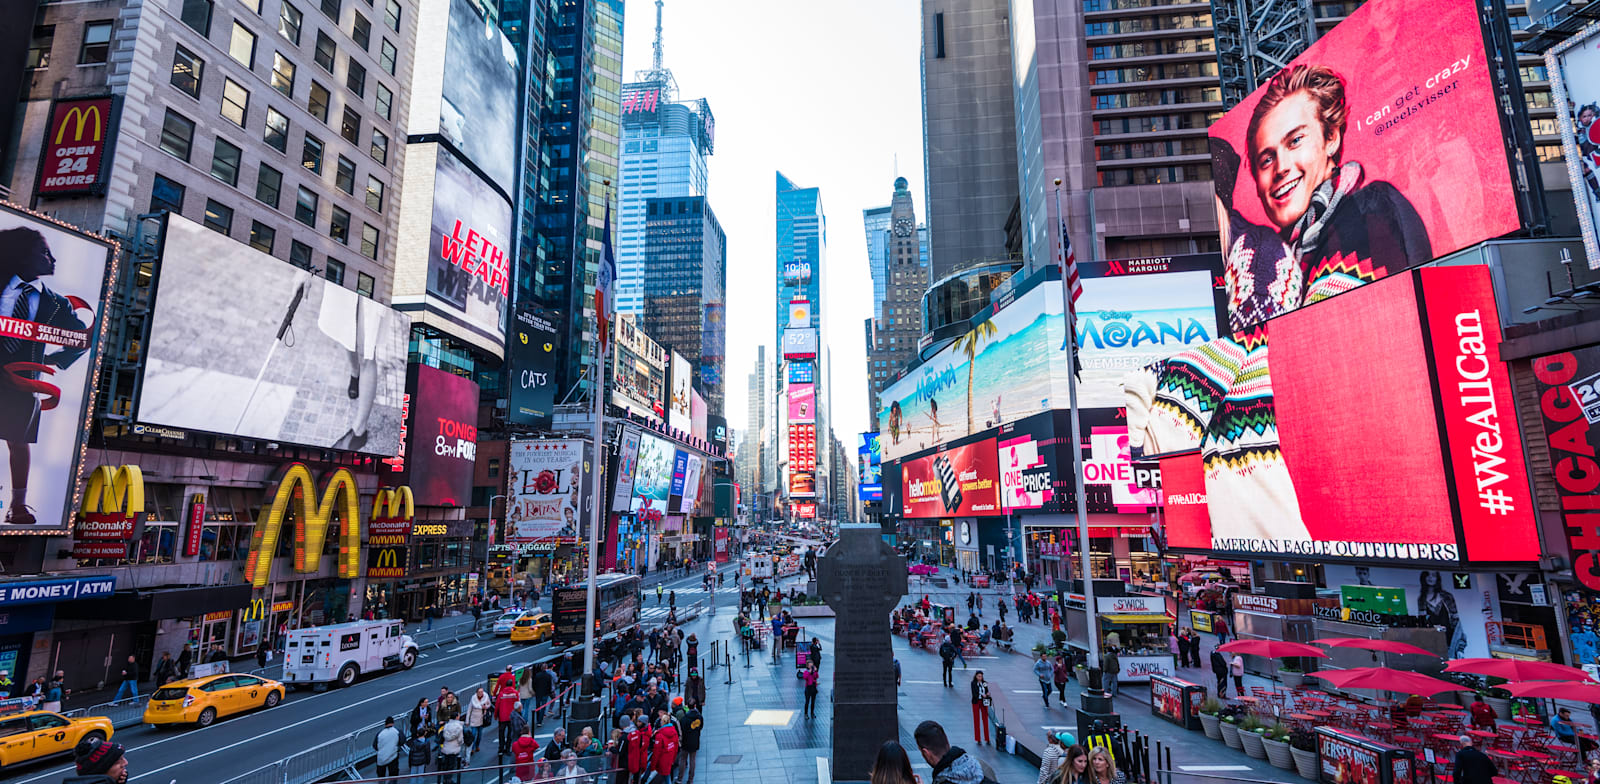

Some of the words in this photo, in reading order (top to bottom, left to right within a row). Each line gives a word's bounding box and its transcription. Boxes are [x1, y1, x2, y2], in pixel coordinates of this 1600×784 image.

[1356, 119, 1361, 131] I
[1365, 104, 1391, 125] can
[1395, 85, 1420, 109] get
[1425, 54, 1471, 88] crazy
[1374, 79, 1459, 136] @neelsvisser
[55, 145, 96, 157] OPEN
[56, 157, 89, 175] 24
[44, 174, 95, 187] HOURS
[1128, 257, 1172, 266] MARRIOTT
[1128, 264, 1168, 273] MARQUIS
[36, 332, 80, 347] JANUARY
[38, 324, 51, 333] SEE
[52, 327, 59, 335] IT
[61, 329, 88, 341] BEFORE
[1060, 317, 1211, 351] MOANA
[521, 369, 547, 389] CATS
[915, 363, 957, 407] MOANA
[1455, 308, 1515, 516] #WeAllCan
[435, 435, 457, 458] 8PM
[1004, 471, 1023, 488] ONE
[1083, 463, 1130, 482] ONE
[1534, 351, 1600, 591] CHICAGO
[1023, 471, 1052, 492] PRICE
[1167, 493, 1208, 505] #WeAllCa
[76, 521, 132, 530] McDonald's
[369, 521, 410, 529] McDonald's
[412, 524, 448, 536] EXPRESS
[1212, 538, 1280, 553] AMERICAN
[1286, 540, 1330, 556] EAGLE
[1337, 542, 1458, 561] OUTFITTERS
[10, 583, 73, 601] MONEY
[80, 581, 113, 594] ATM
[1236, 594, 1279, 610] VIRGIL'S
[1320, 740, 1352, 760] JERSEY
